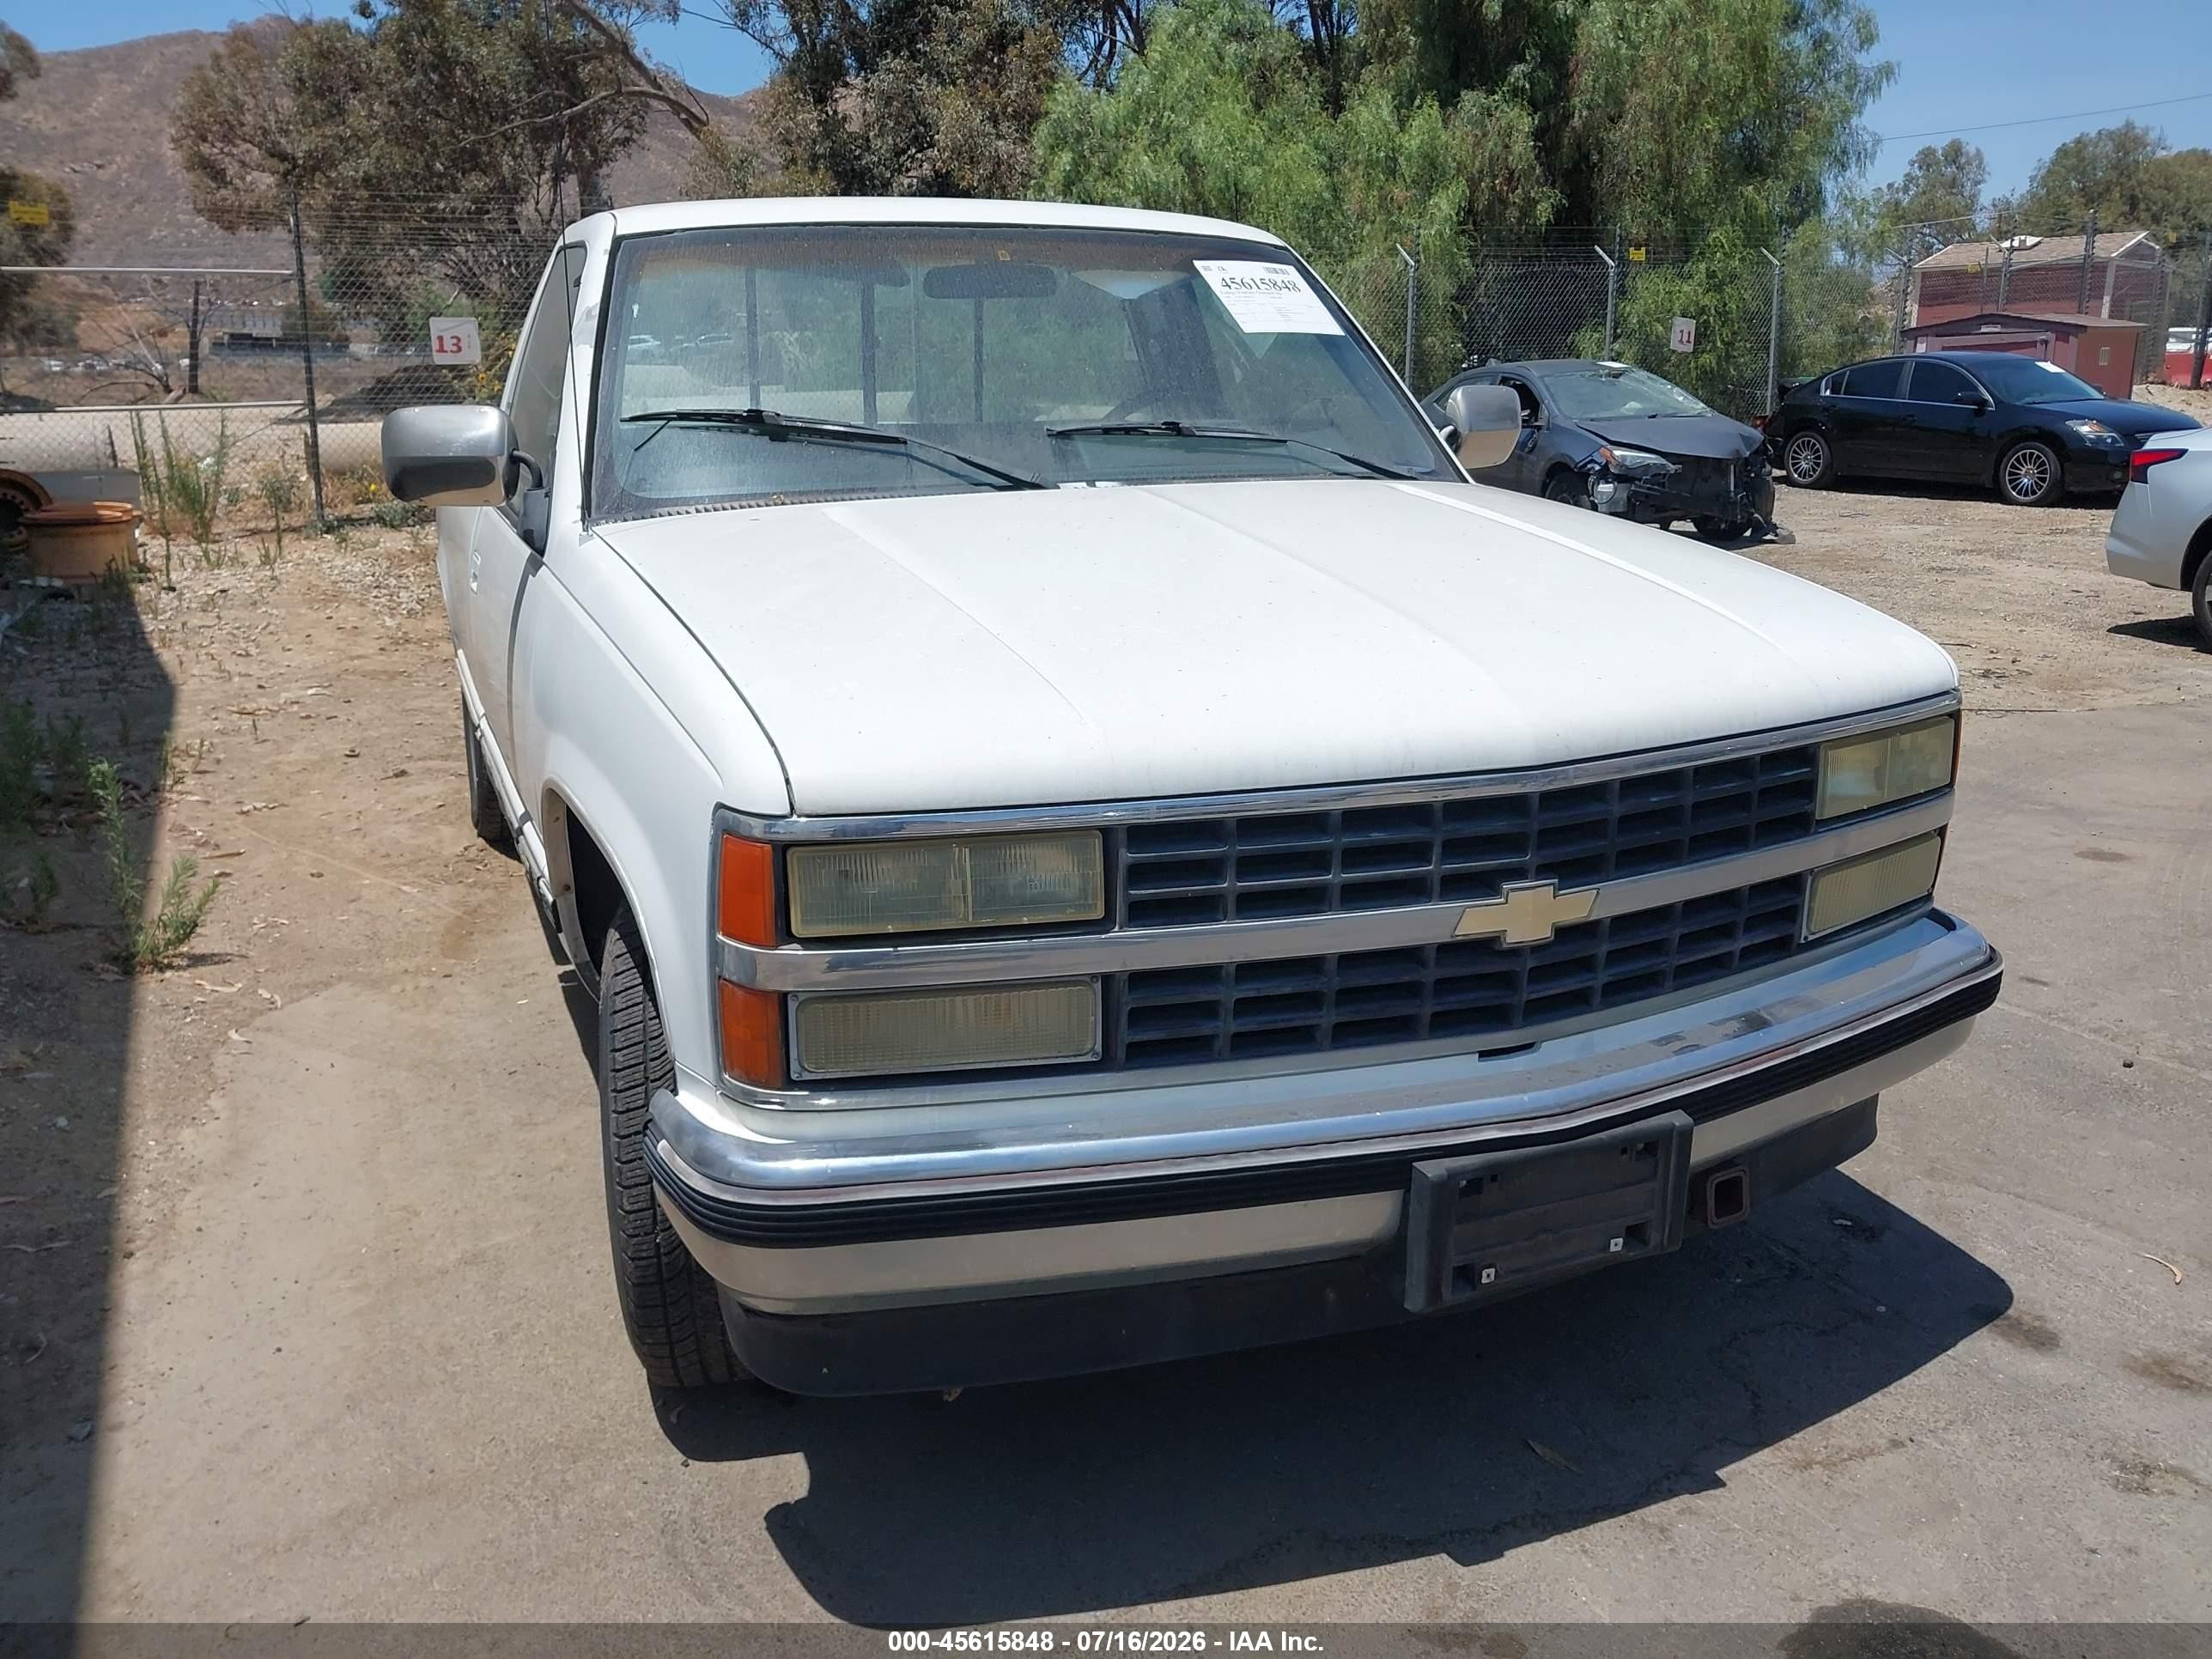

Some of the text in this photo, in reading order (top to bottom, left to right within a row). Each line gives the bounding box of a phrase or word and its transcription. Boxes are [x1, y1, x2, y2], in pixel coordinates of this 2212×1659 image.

[1221, 276, 1301, 292] 45615848
[434, 335, 463, 354] 13
[1678, 329, 1692, 344] 11
